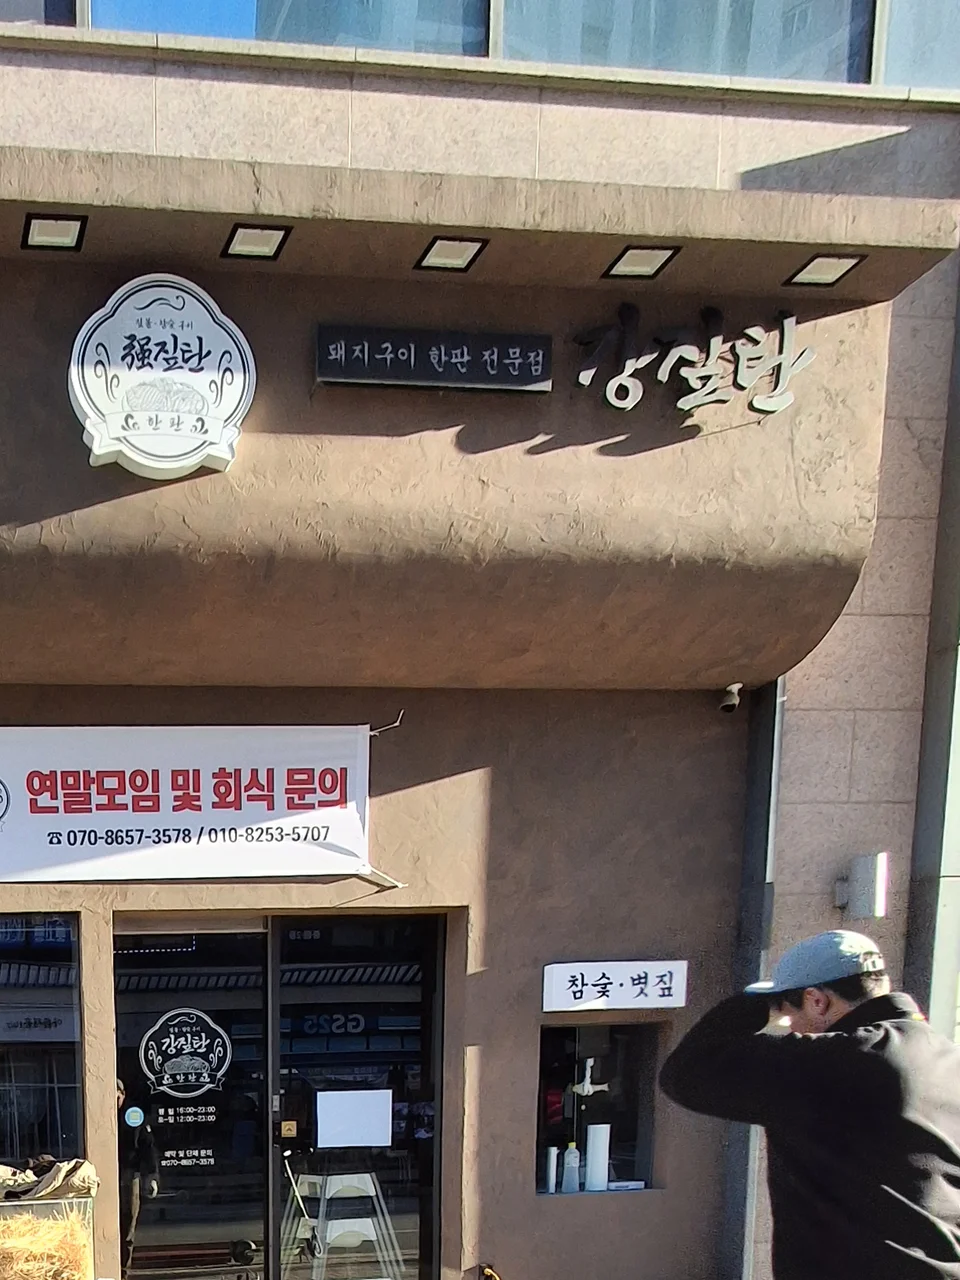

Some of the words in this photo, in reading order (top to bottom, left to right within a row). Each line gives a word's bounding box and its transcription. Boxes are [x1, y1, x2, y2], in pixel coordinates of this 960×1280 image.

[327, 340, 416, 370] 돼지구이
[428, 344, 472, 372] 한판
[480, 346, 545, 376] 전문점
[25, 768, 162, 814] 연말모임
[171, 768, 202, 813] 및
[211, 767, 275, 811] 회식
[283, 767, 348, 810] 문의
[66, 827, 192, 846] 070-8657-3578
[208, 825, 330, 844] 010-8253-5707
[160, 1032, 211, 1055] 강짚탄
